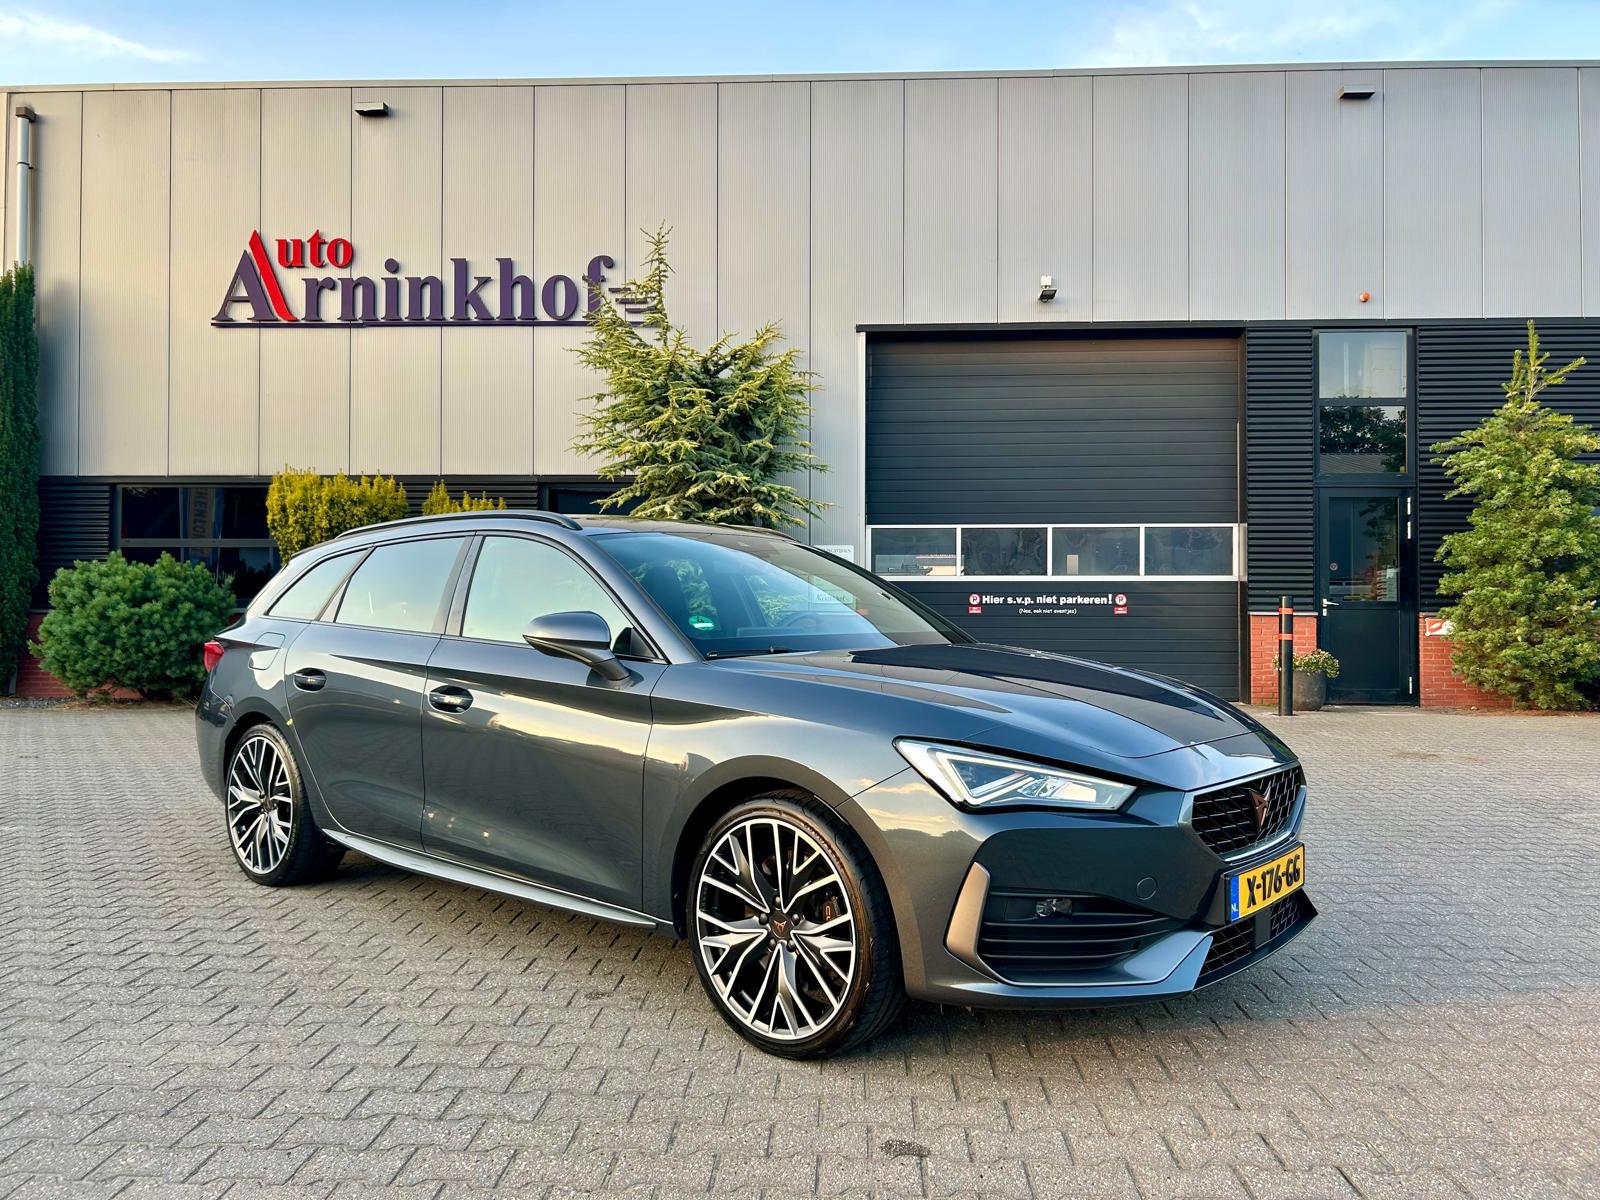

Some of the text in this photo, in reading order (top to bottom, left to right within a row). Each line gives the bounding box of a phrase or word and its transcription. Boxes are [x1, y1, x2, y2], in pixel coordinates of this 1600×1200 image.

[211, 235, 615, 321] Arninkhof
[982, 594, 1113, 605] Hier s.v.p. niet parkeren!
[1247, 854, 1300, 908] X-176-GG
[1231, 902, 1239, 912] NL
